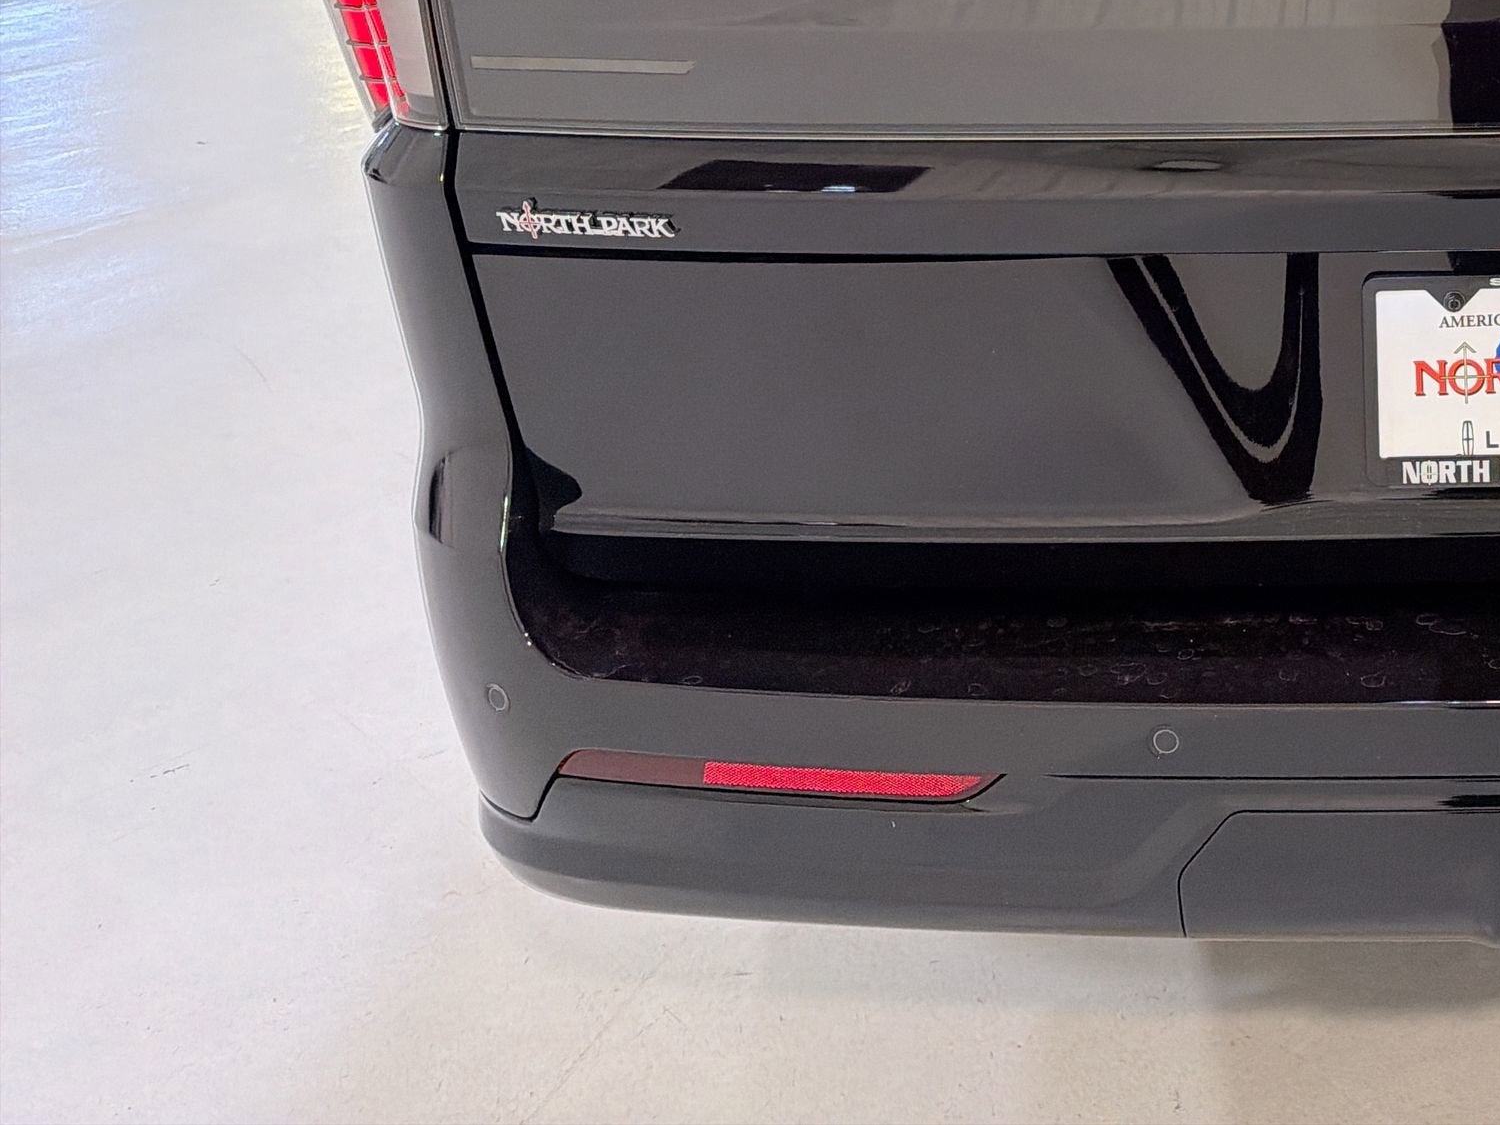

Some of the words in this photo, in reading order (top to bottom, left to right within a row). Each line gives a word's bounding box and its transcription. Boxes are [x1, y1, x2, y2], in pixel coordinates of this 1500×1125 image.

[496, 210, 594, 235] NORTH
[596, 215, 676, 238] PARK
[1402, 459, 1491, 485] NORTH
